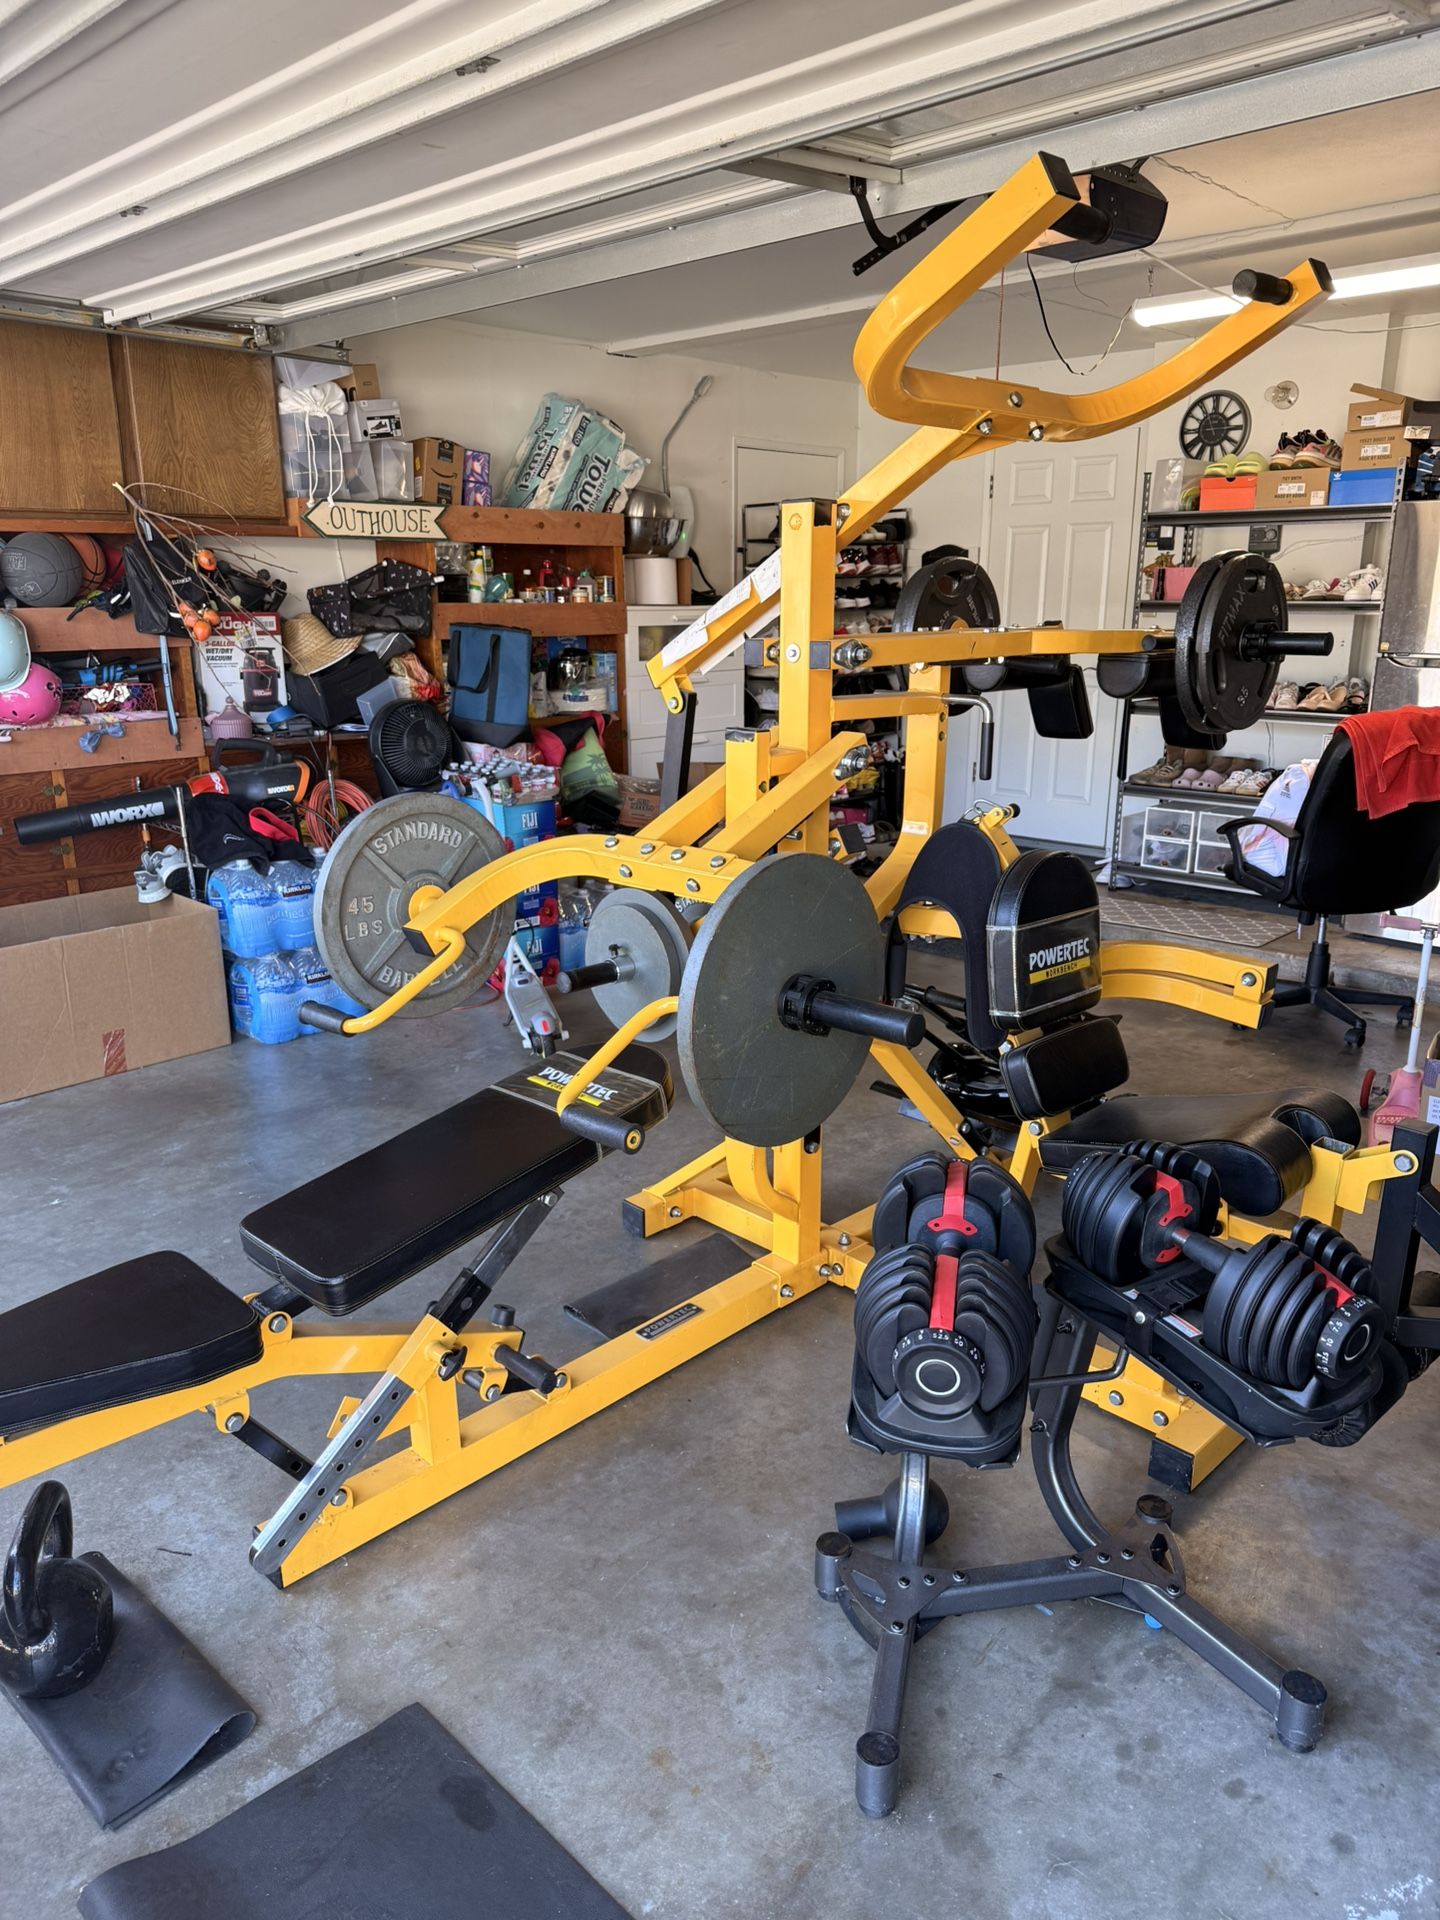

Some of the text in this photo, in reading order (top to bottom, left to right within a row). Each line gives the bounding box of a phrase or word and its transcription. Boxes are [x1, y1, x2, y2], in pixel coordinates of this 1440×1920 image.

[517, 428, 558, 490] Towel
[571, 453, 612, 512] Towe
[329, 505, 431, 535] OUTHOUSE
[1217, 582, 1248, 647] FITMAX
[96, 802, 158, 827] WORX
[521, 811, 539, 829] FIJI
[373, 820, 463, 855] STANDARD
[348, 895, 375, 915] 45
[344, 919, 384, 941] LBS
[1029, 937, 1090, 971] POWERTEC
[378, 962, 464, 989] BARLL
[1045, 962, 1078, 979] WORKBENCH
[538, 1066, 619, 1101] POWTEC
[643, 1304, 692, 1334] POWERTEC
[1332, 1320, 1344, 1333] 7.5
[1344, 1310, 1352, 1318] 5
[1325, 1337, 1334, 1348] 10
